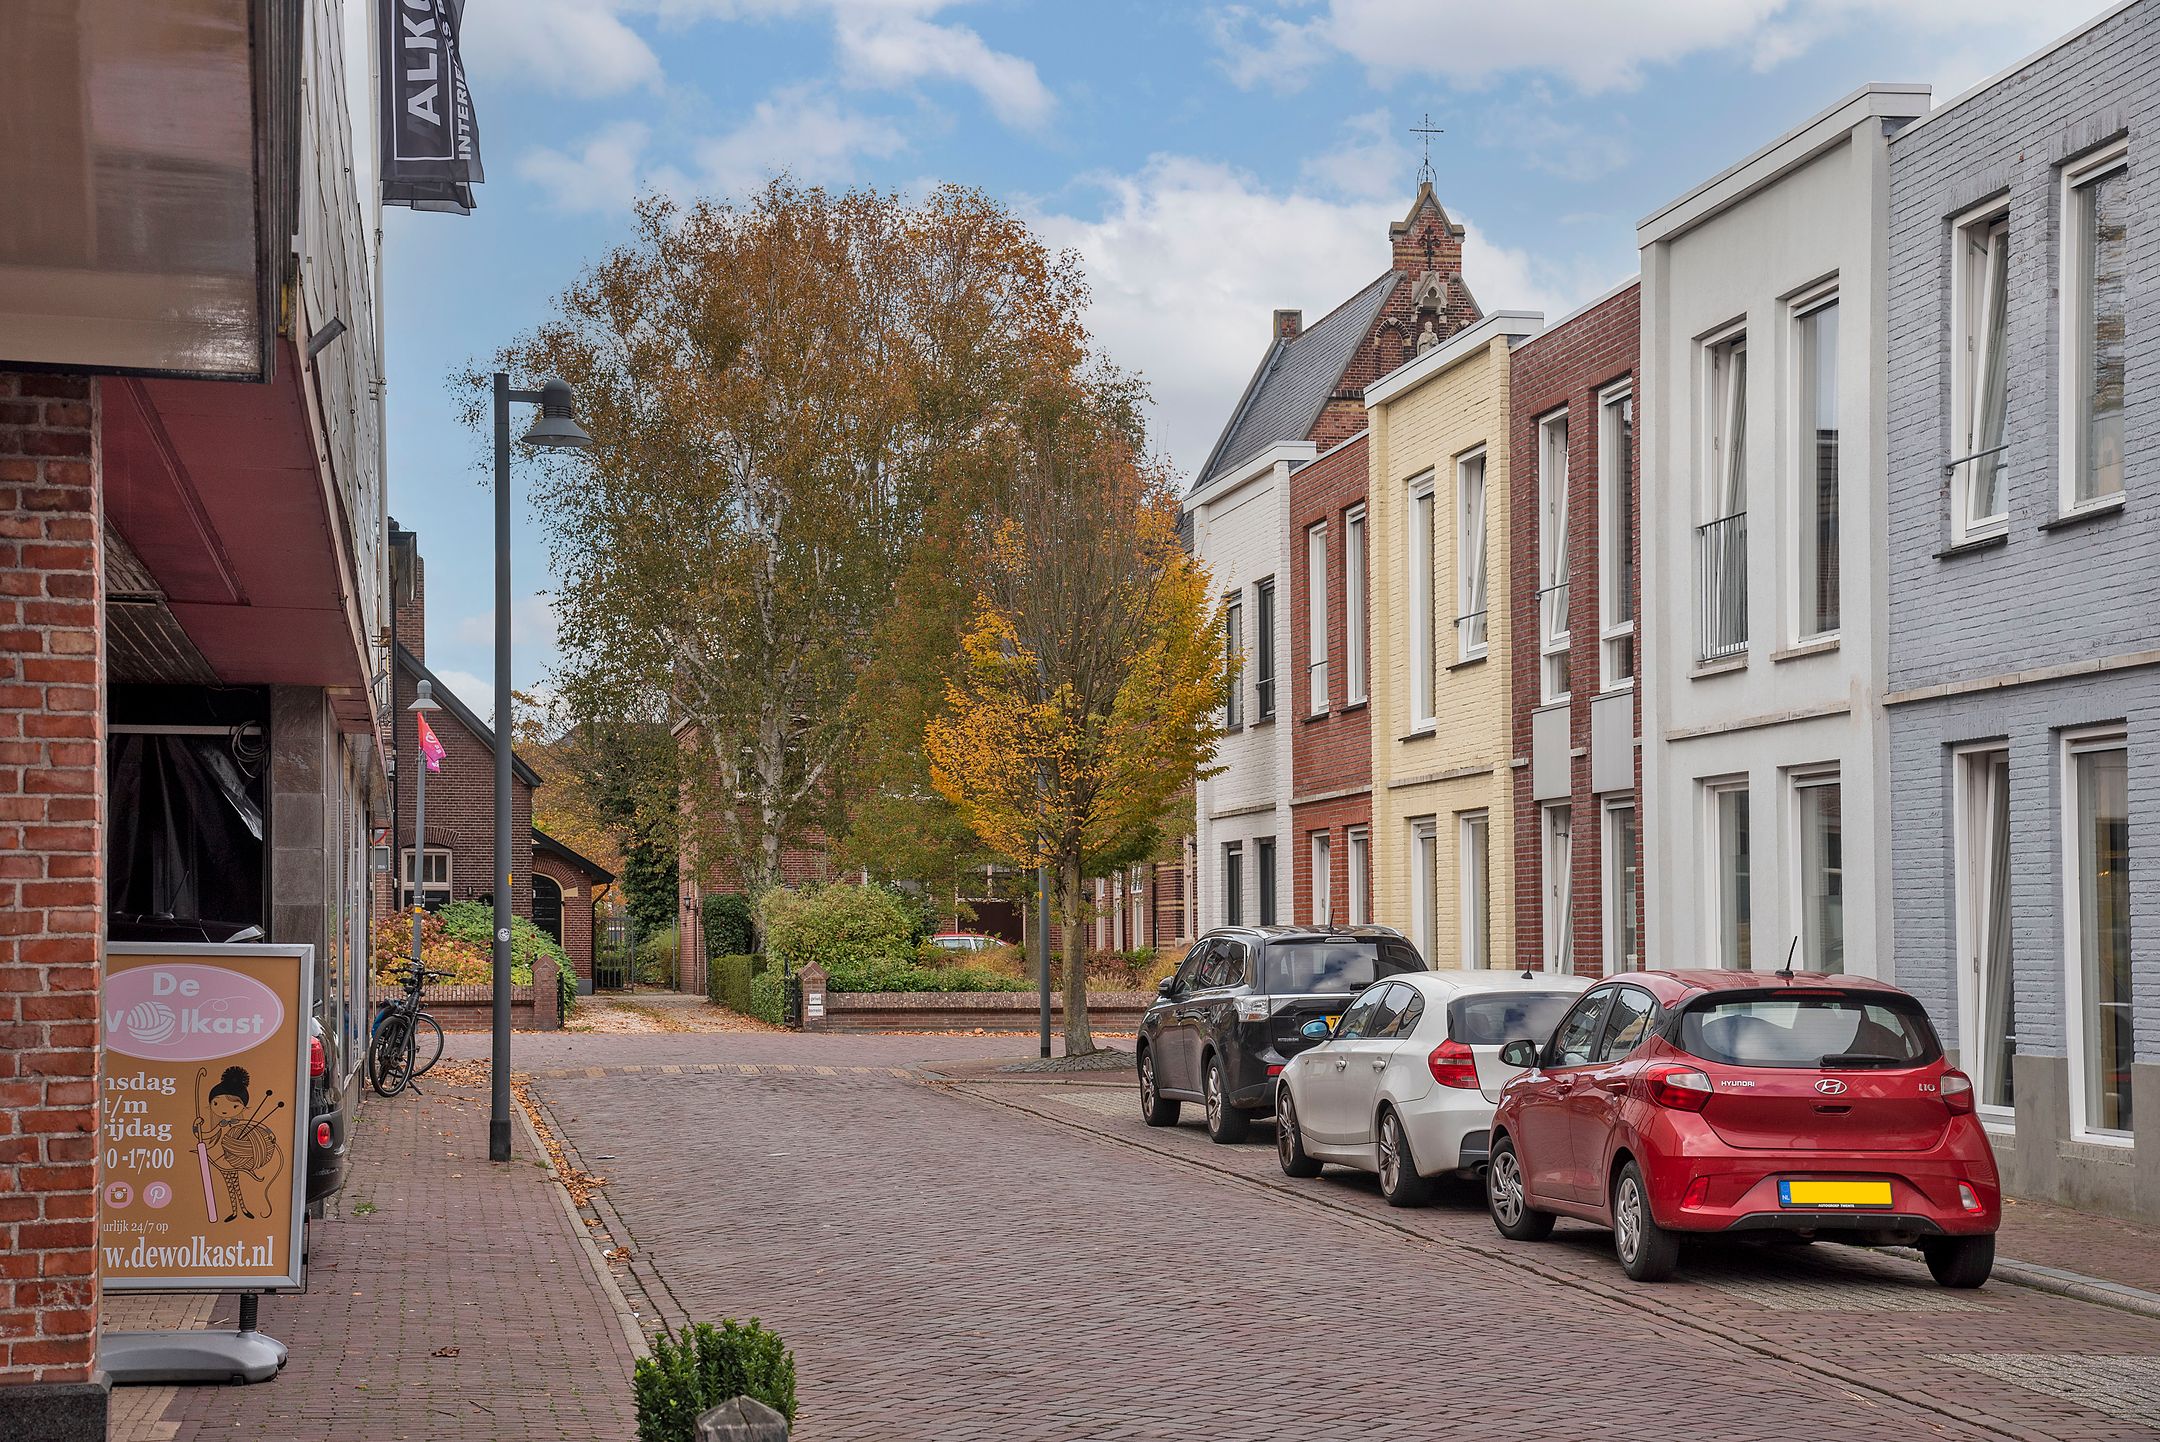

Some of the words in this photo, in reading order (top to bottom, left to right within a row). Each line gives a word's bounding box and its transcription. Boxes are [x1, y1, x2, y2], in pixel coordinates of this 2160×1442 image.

[152, 972, 201, 997] De
[131, 1220, 154, 1234] 24/7
[156, 1222, 169, 1234] op
